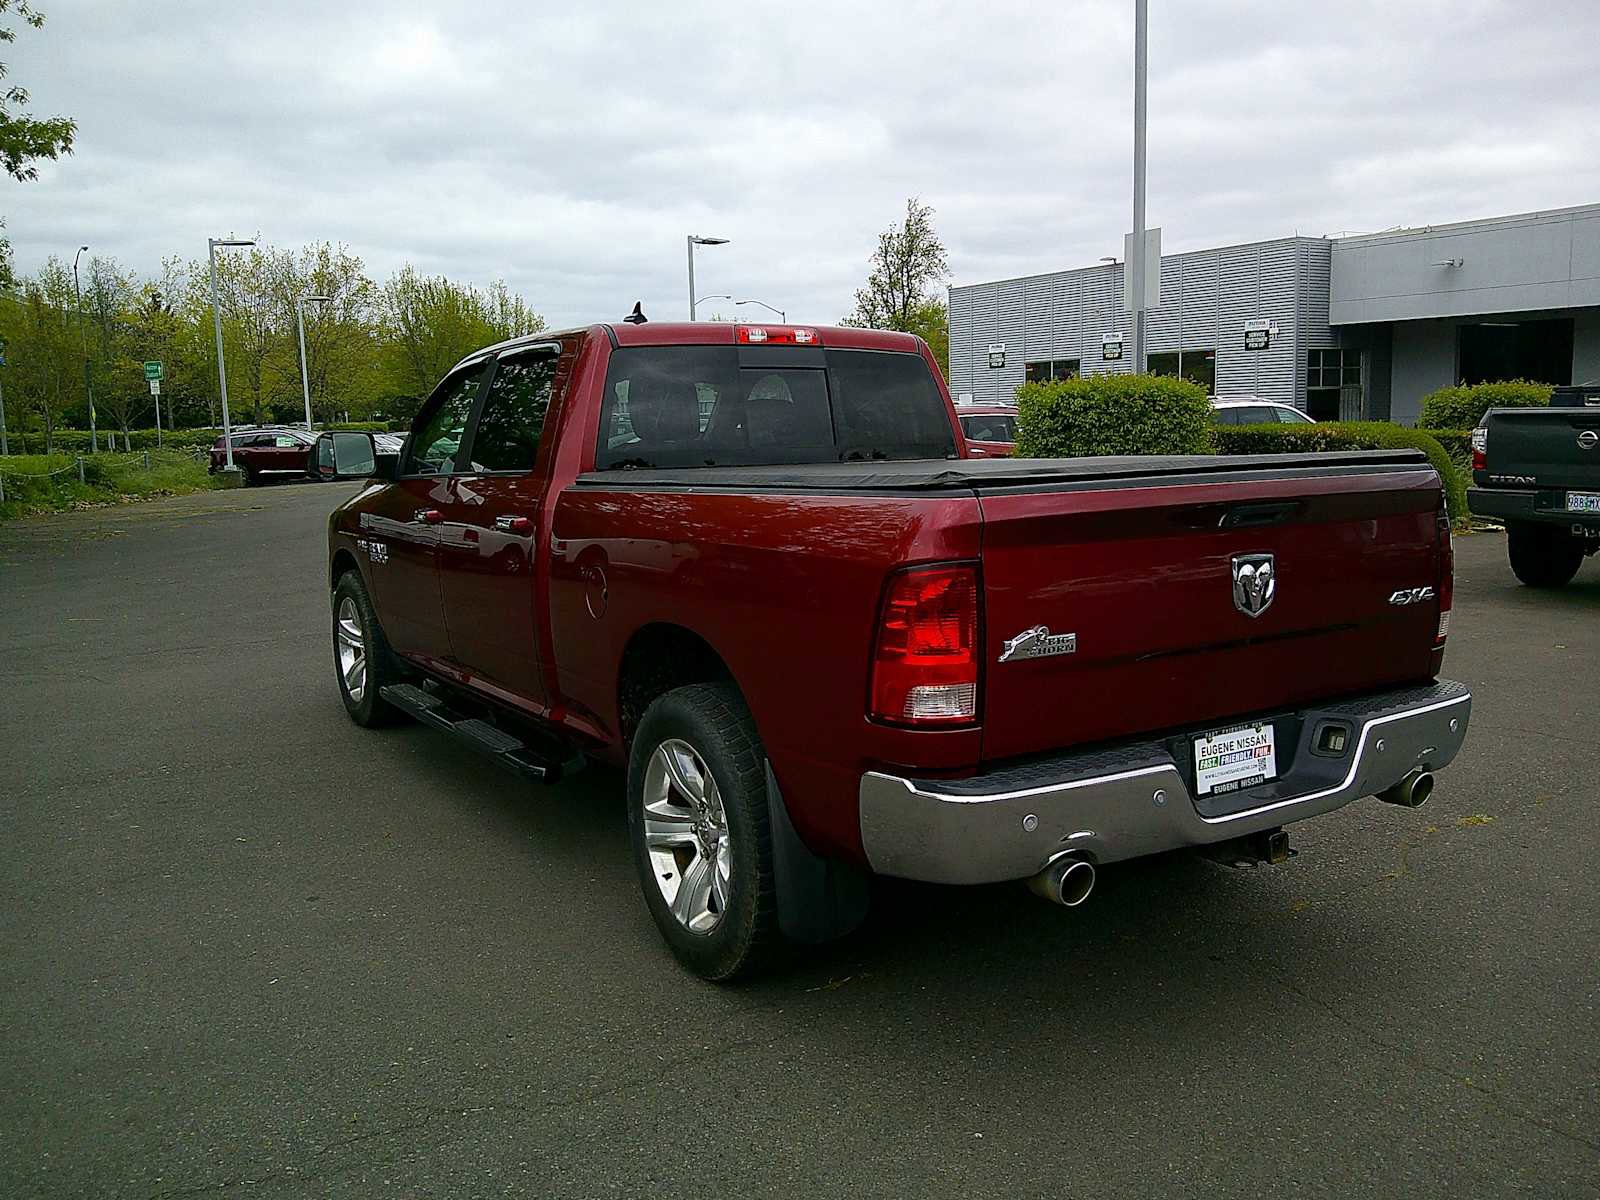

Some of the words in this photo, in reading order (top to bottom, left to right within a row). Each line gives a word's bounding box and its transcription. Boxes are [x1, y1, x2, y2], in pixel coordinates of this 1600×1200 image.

[1489, 475, 1536, 484] TITAN
[1048, 636, 1071, 646] BIG
[1037, 644, 1074, 655] HORN
[1201, 741, 1235, 757] EUGENE
[1236, 734, 1267, 750] NISSAN
[1213, 780, 1239, 794] EUGENE
[1240, 775, 1264, 788] NISSAN
